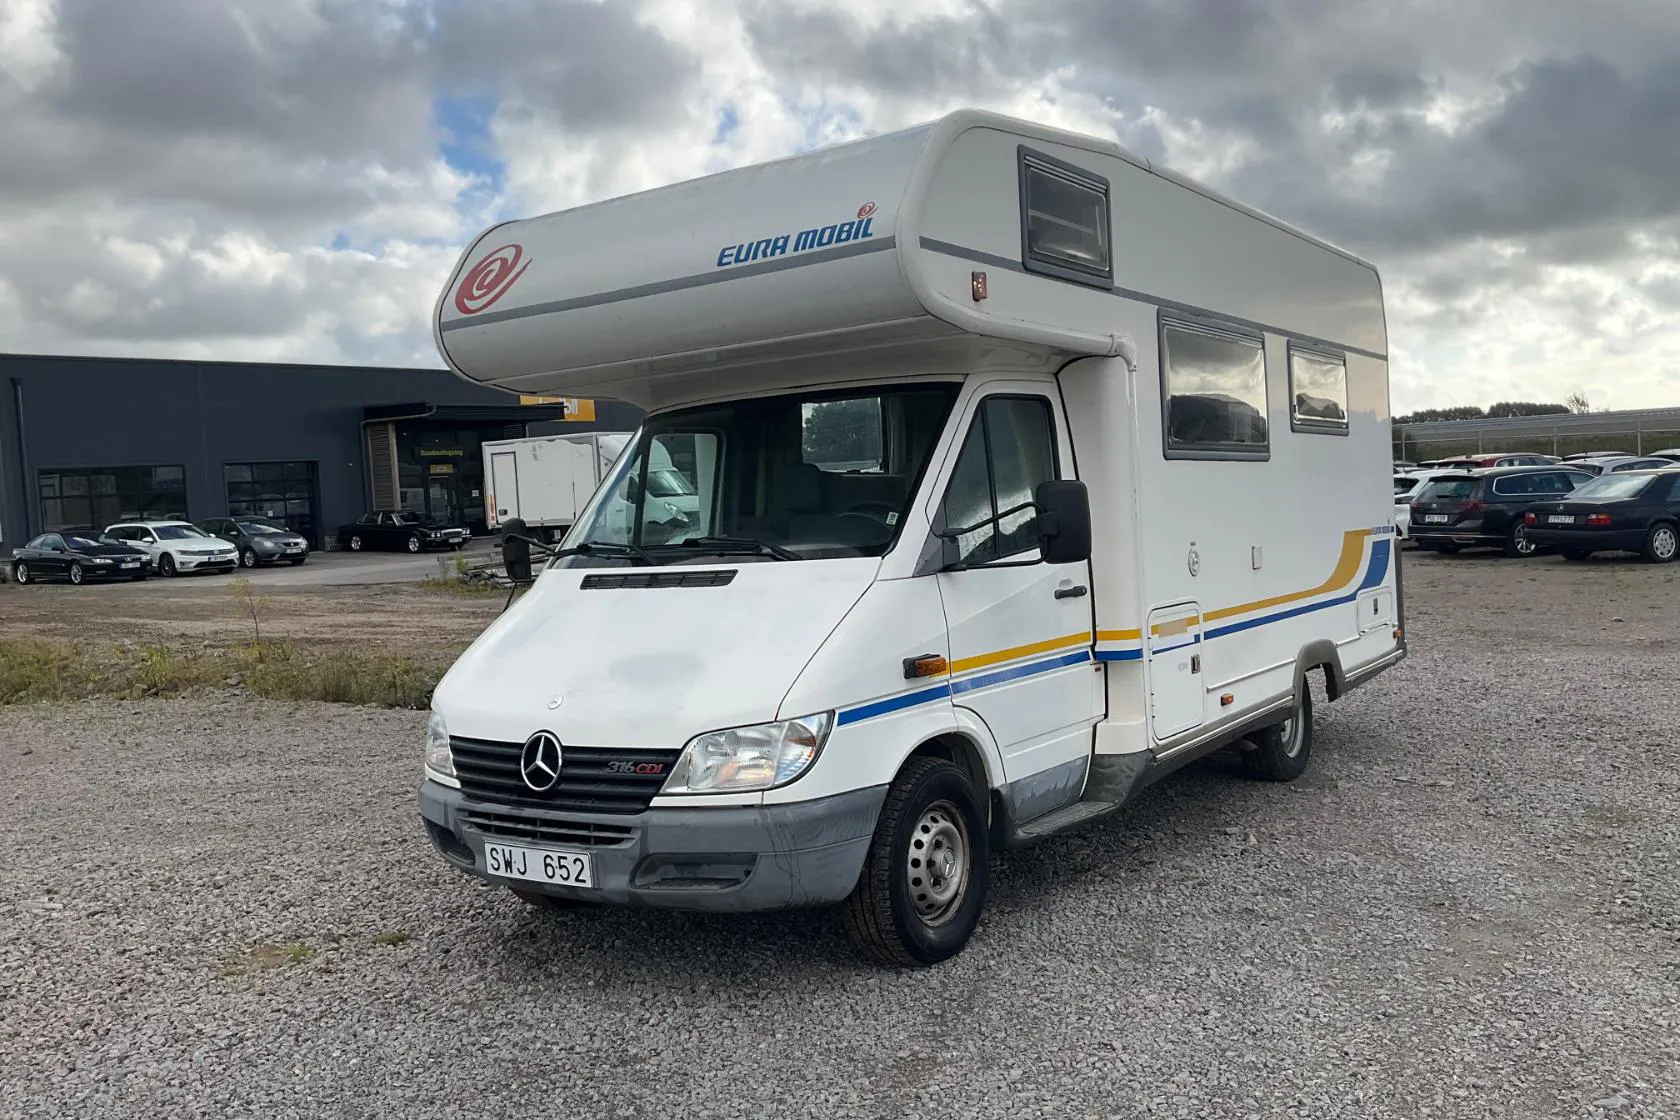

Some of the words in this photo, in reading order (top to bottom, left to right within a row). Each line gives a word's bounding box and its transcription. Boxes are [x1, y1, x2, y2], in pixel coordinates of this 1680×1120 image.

[717, 234, 791, 267] EURA
[793, 217, 874, 252] MOBIL
[490, 847, 527, 875] SWJ
[543, 854, 586, 883] 652
